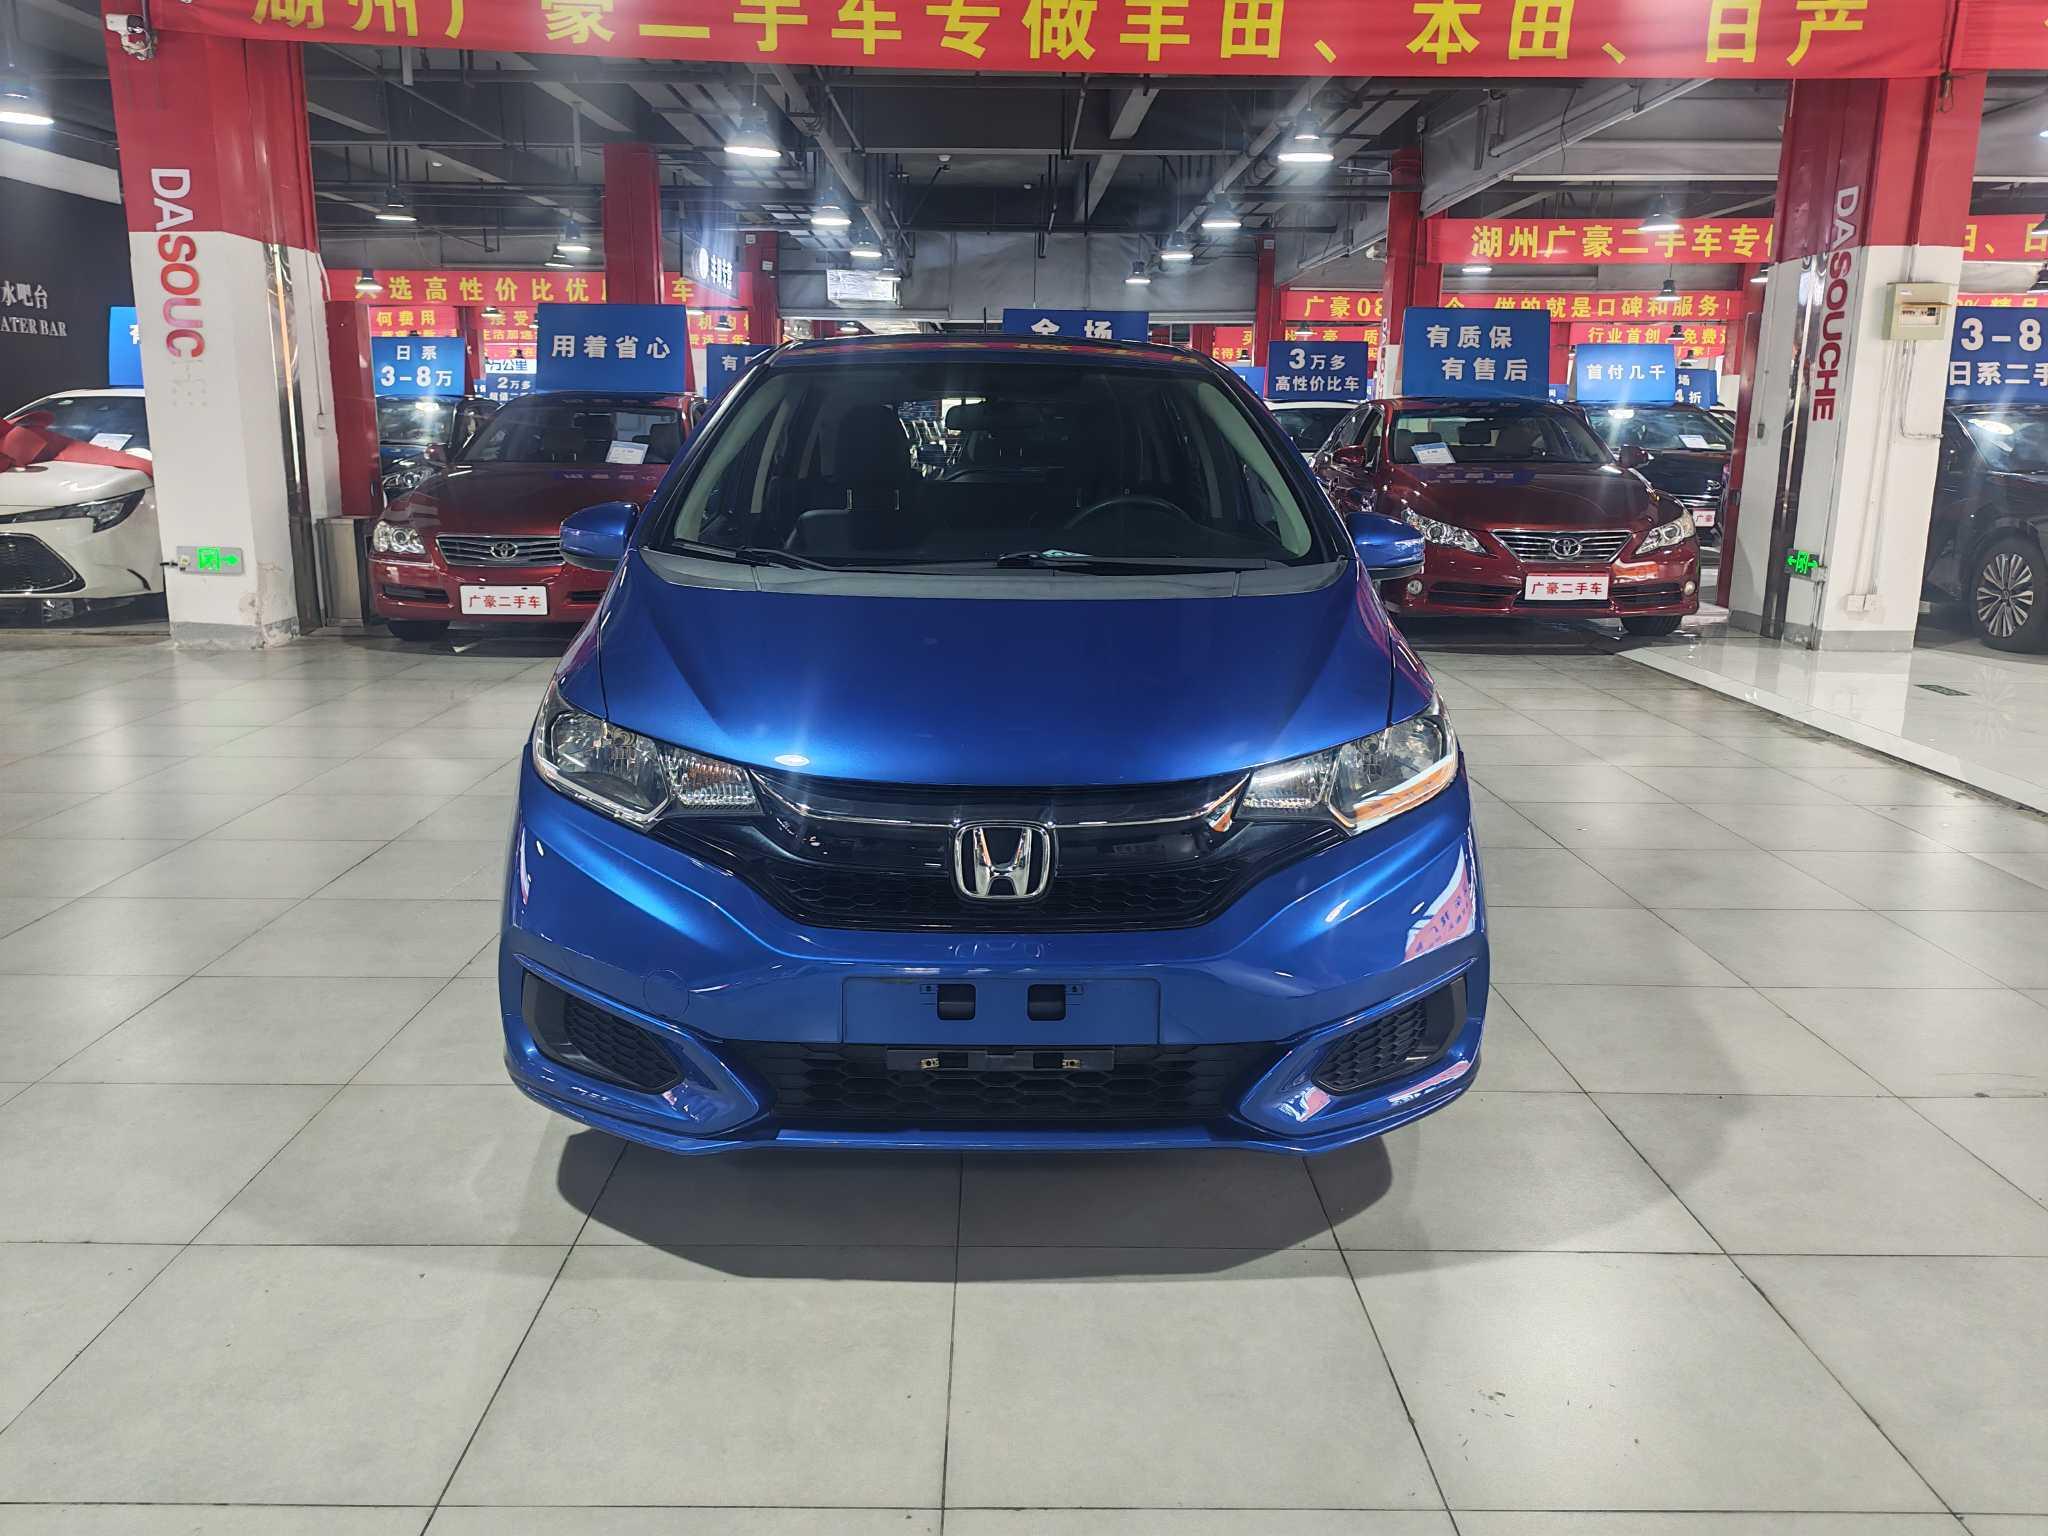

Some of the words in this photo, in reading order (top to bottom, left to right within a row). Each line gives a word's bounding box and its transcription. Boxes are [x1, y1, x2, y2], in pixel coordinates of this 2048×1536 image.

[1471, 224, 1774, 258] 湖州广豪二手车专
[355, 275, 607, 302] 选高性价比优
[672, 277, 695, 302] 车
[1812, 185, 1860, 421] DASOUCHE
[39, 319, 68, 337] BAR
[1426, 324, 1513, 349] 有质保
[396, 344, 438, 361] 日系
[551, 333, 671, 360] 用着省心
[1289, 348, 1346, 371] 3万多
[1441, 356, 1529, 382] 有售后
[380, 365, 454, 388] 3-8万
[1275, 375, 1360, 392] 高性价比车
[1586, 364, 1666, 380] 首付几千
[1531, 582, 1603, 596] 广豪二手车
[469, 594, 541, 609] 广豪二手车
